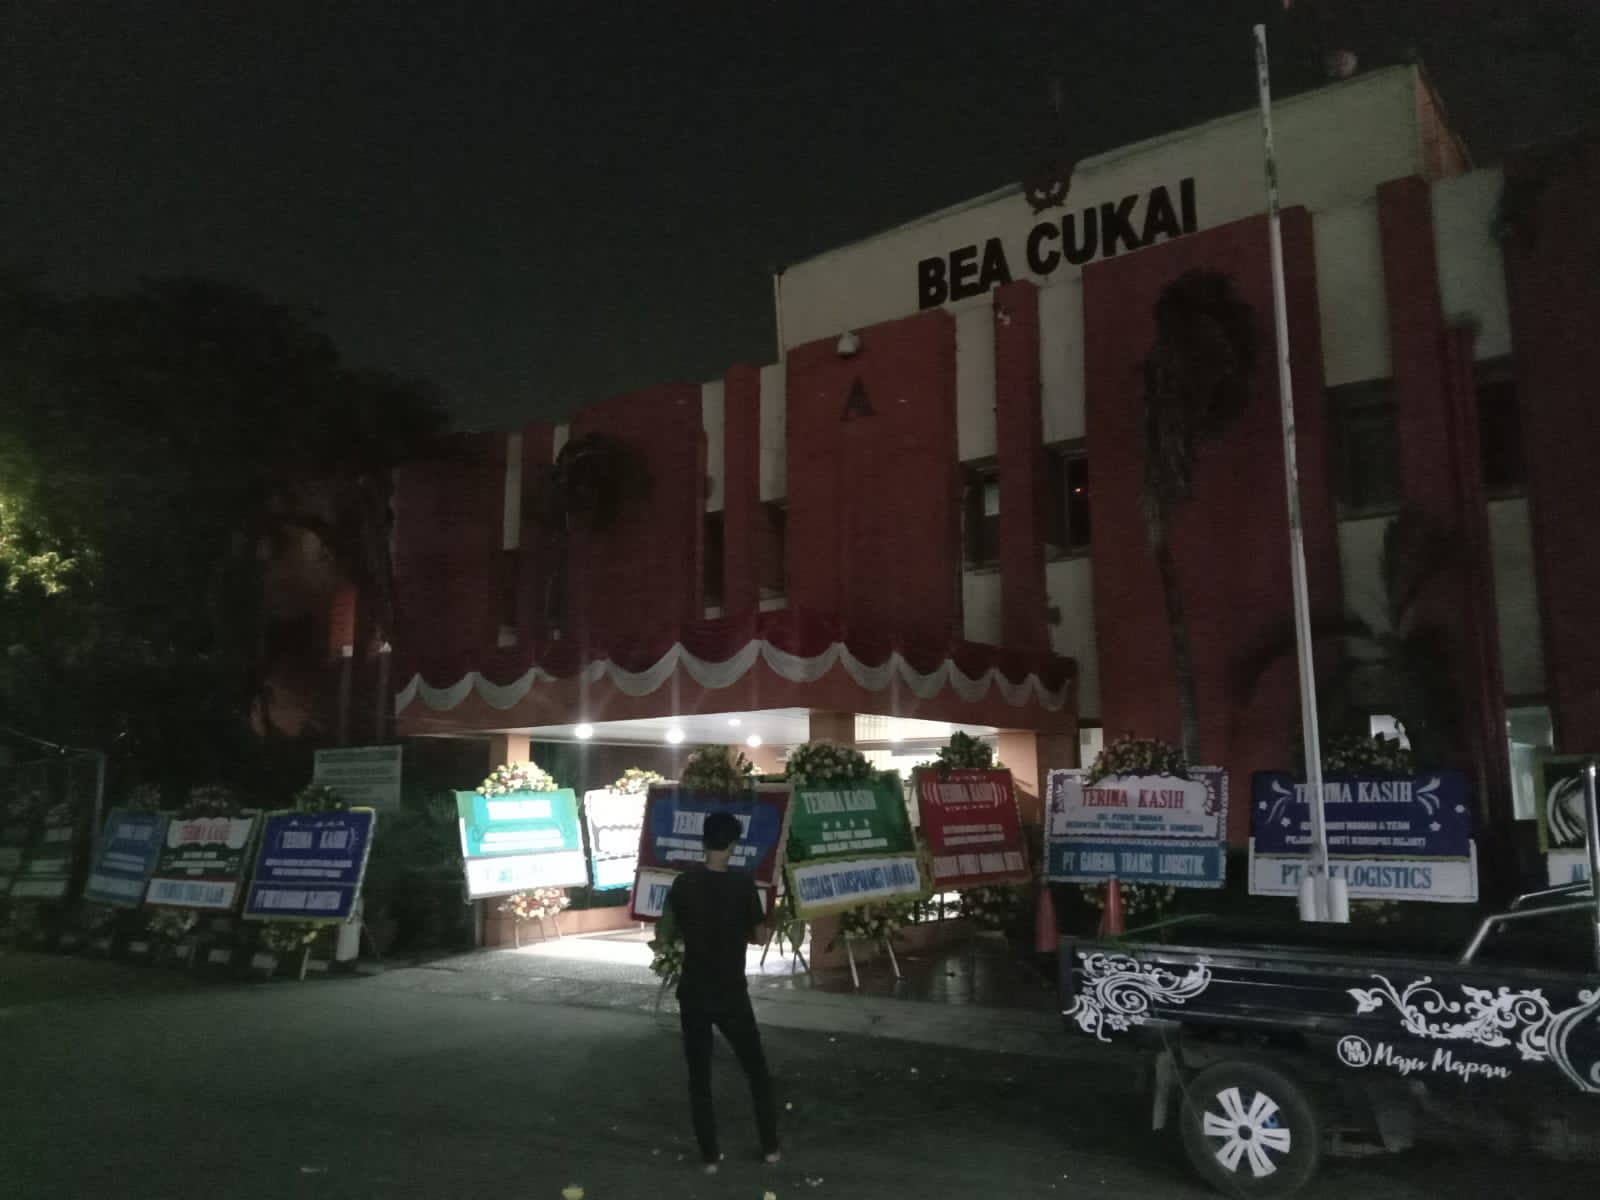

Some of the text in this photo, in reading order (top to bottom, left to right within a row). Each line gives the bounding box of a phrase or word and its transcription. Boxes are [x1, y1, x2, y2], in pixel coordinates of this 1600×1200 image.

[918, 178, 1198, 309] BEA CUKAI
[1082, 789, 1185, 809] TERIMA KASIH
[1358, 781, 1414, 803] KASIH
[1281, 864, 1300, 885] PT
[1345, 866, 1432, 889] LOGISTICS
[1431, 1047, 1512, 1084] Mapan
